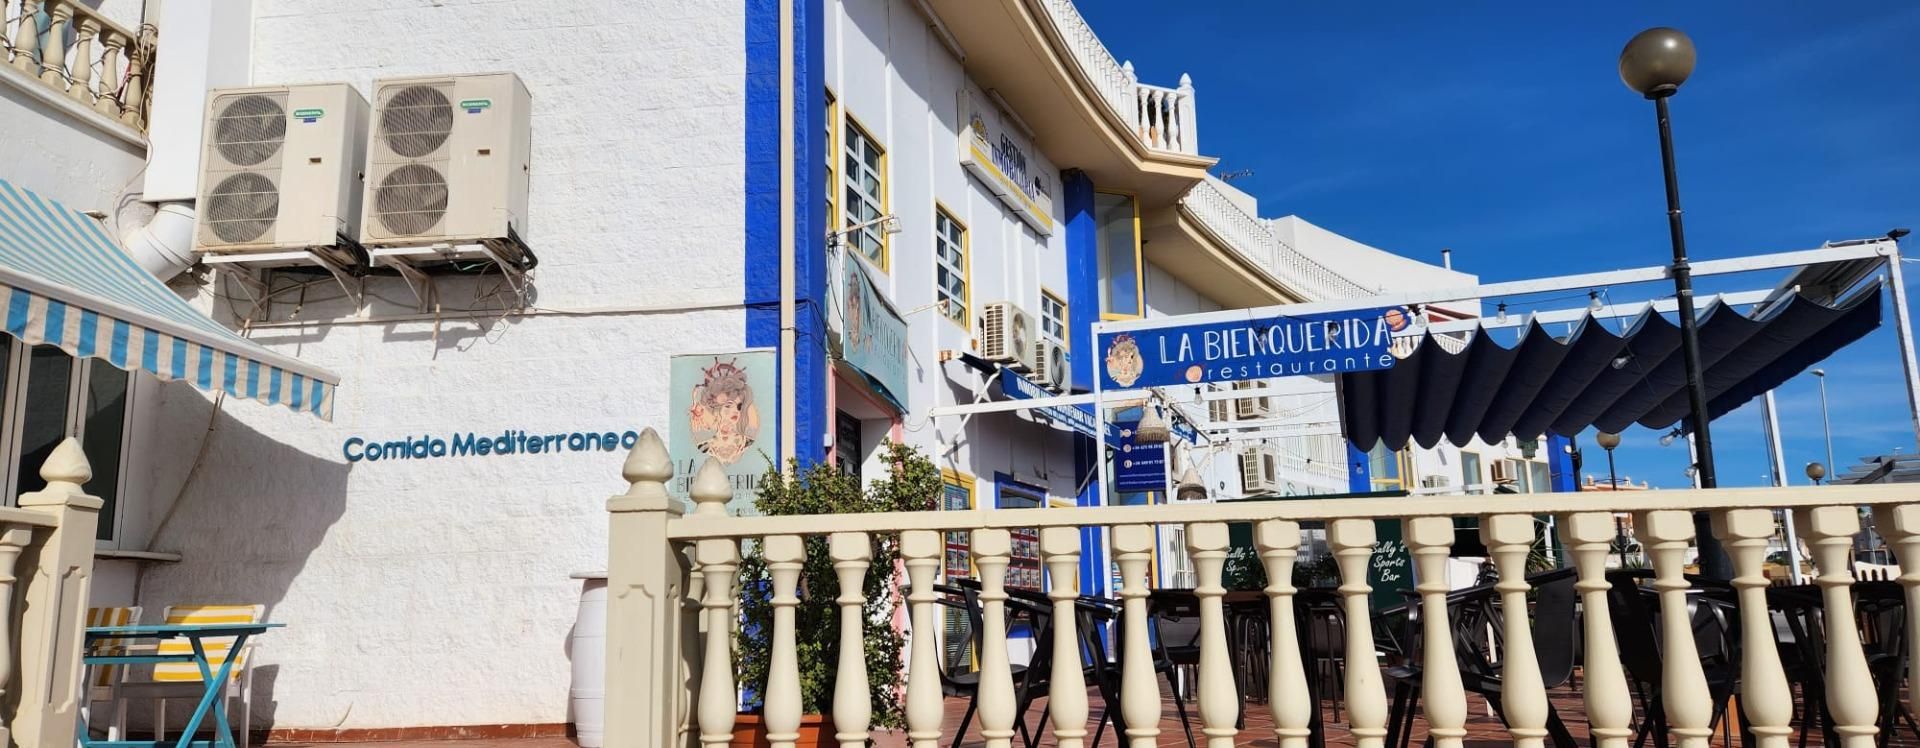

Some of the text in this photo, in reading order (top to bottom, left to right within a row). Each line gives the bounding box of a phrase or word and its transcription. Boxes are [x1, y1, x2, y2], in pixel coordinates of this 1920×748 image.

[1160, 314, 1392, 365] LA BIENQUERIDA
[1208, 352, 1392, 380] restaurante
[343, 435, 447, 463] Comida
[679, 458, 697, 475] LA
[1373, 555, 1405, 572] Sports
[1381, 568, 1400, 582] Bar
